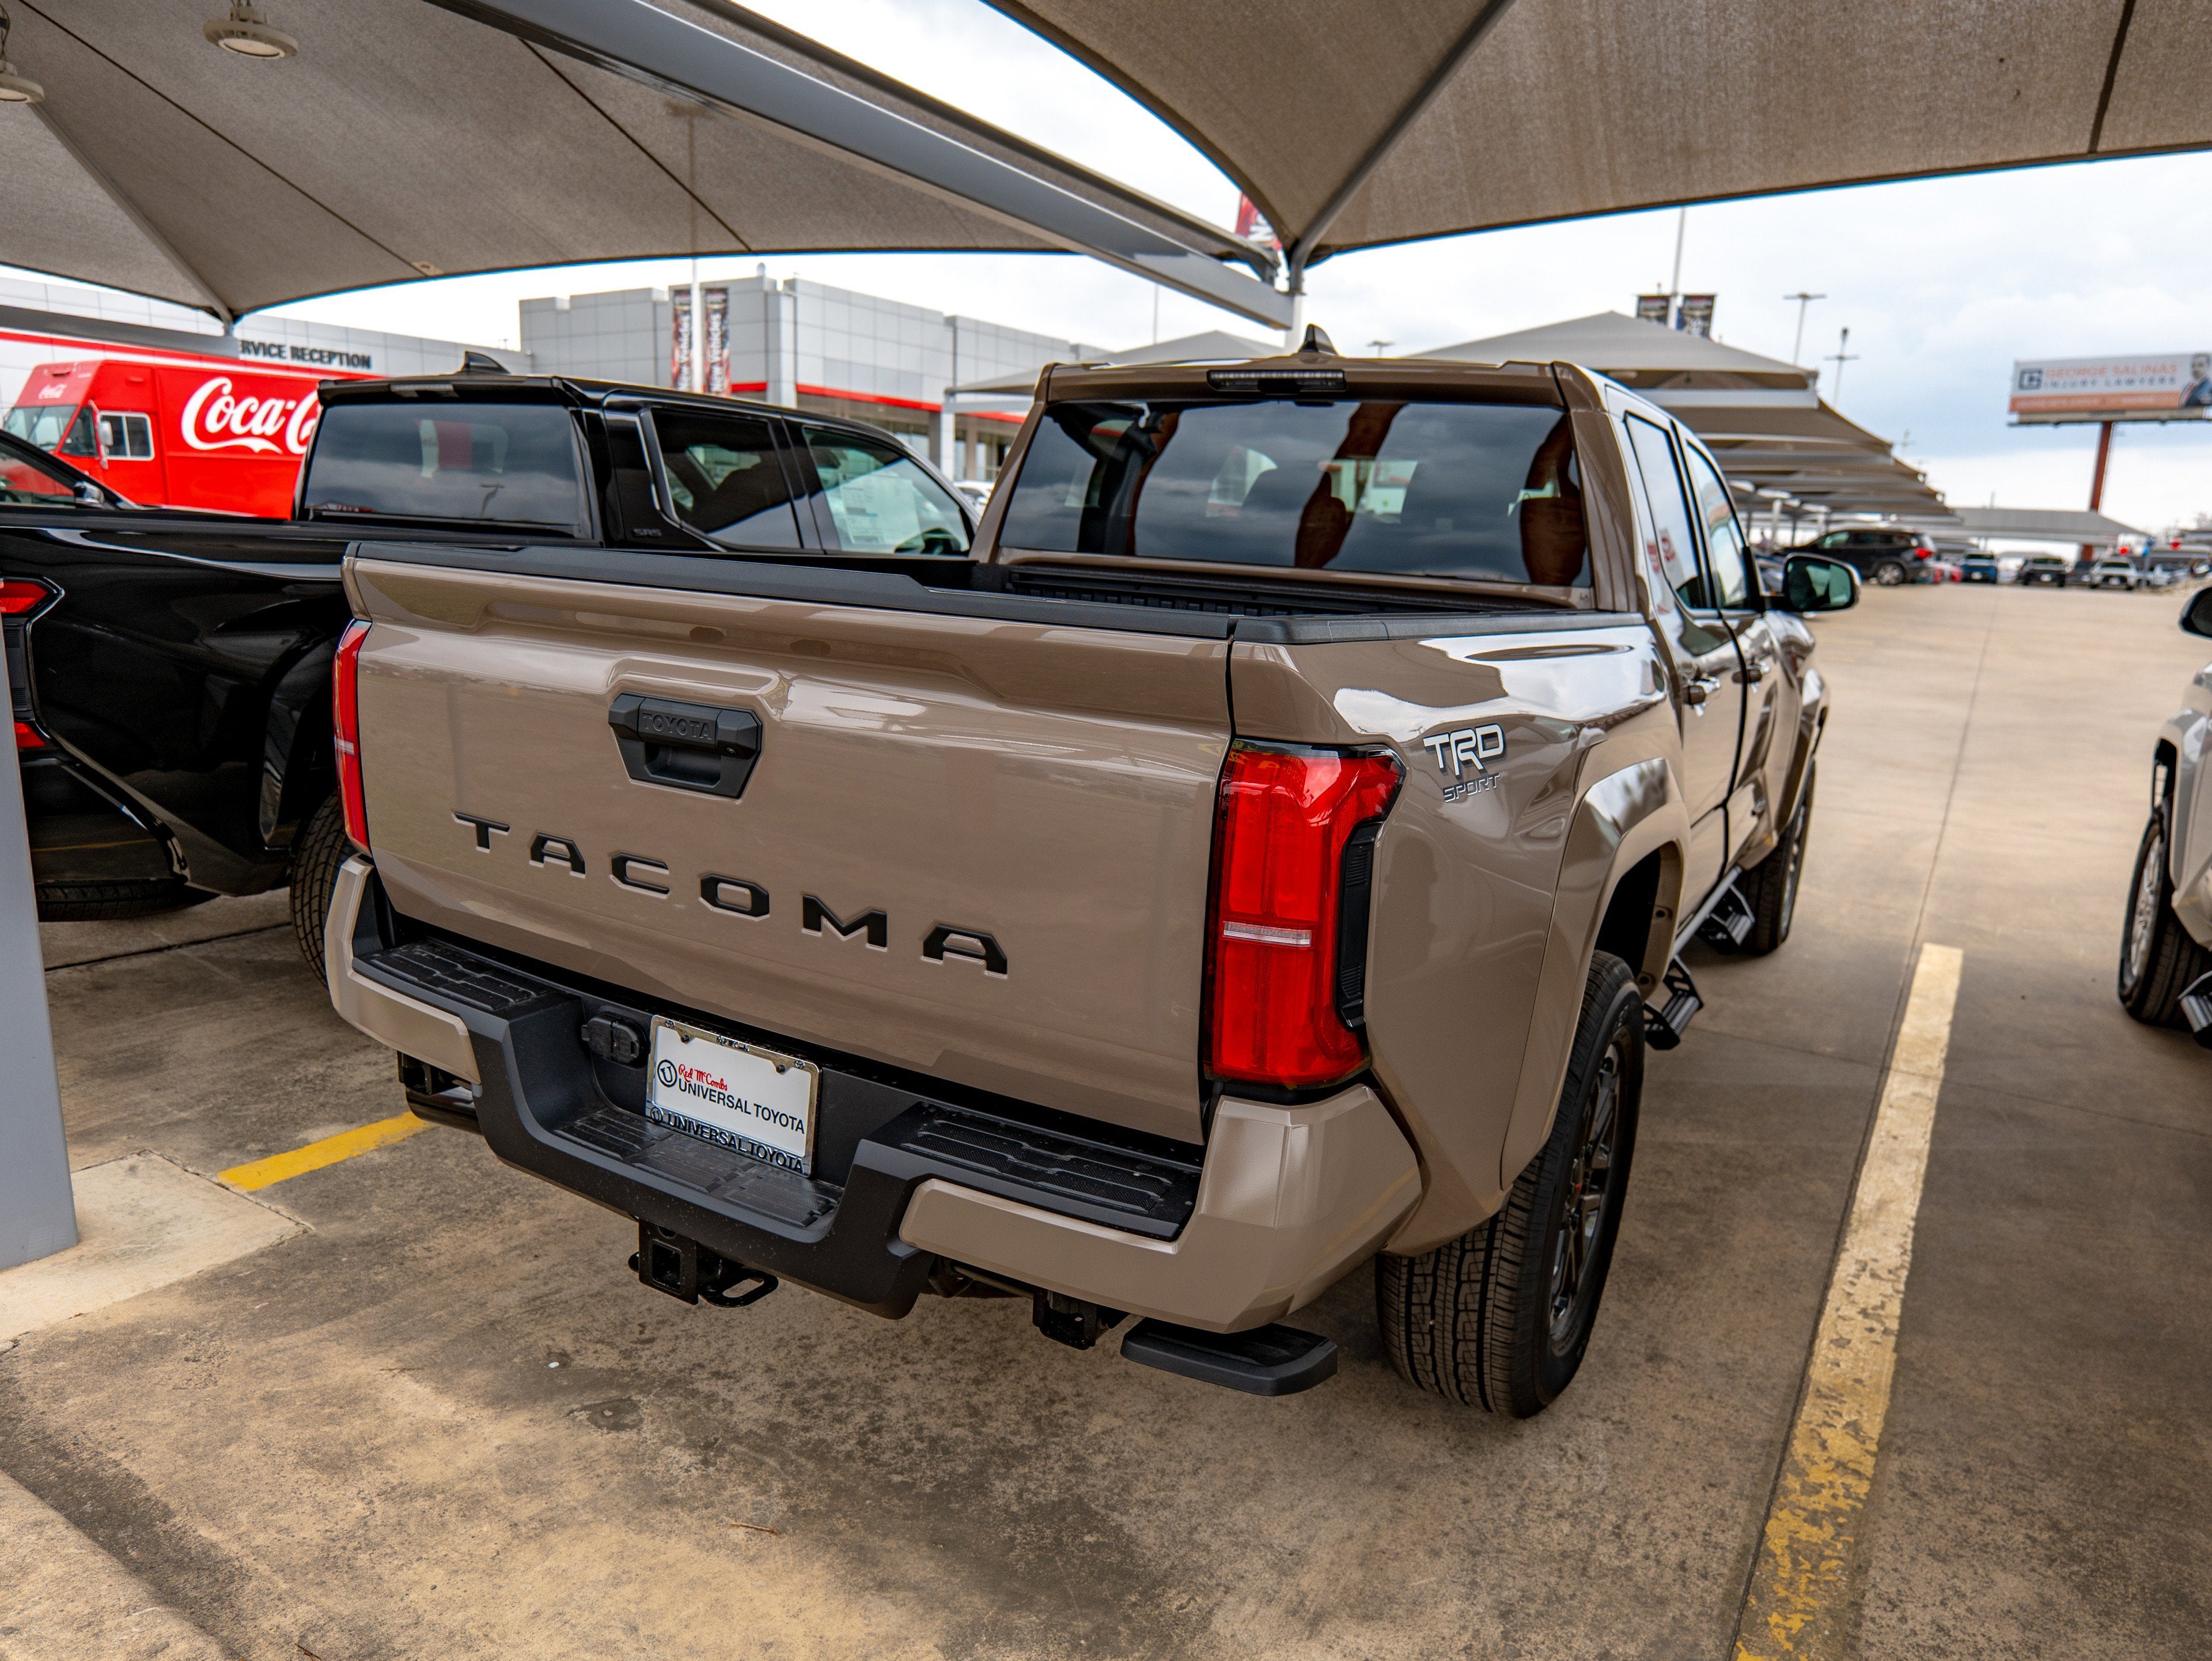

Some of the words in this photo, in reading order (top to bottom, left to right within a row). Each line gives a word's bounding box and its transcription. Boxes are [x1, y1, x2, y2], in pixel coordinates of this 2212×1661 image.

[240, 340, 286, 360] RVICE
[290, 346, 372, 369] RECEPTION
[709, 313, 722, 364] Vehicles
[710, 364, 724, 392] New
[642, 712, 712, 740] TOYOTA
[1422, 722, 1506, 777] TRD
[1442, 773, 1501, 803] SPORT
[452, 810, 1009, 979] TACOMA
[678, 1064, 693, 1083] Red
[679, 1078, 751, 1115] UNIVERSAL
[753, 1103, 805, 1134] TOYOTA
[668, 1112, 747, 1152] UNIVERSAL
[748, 1139, 804, 1174] TOYOTA
